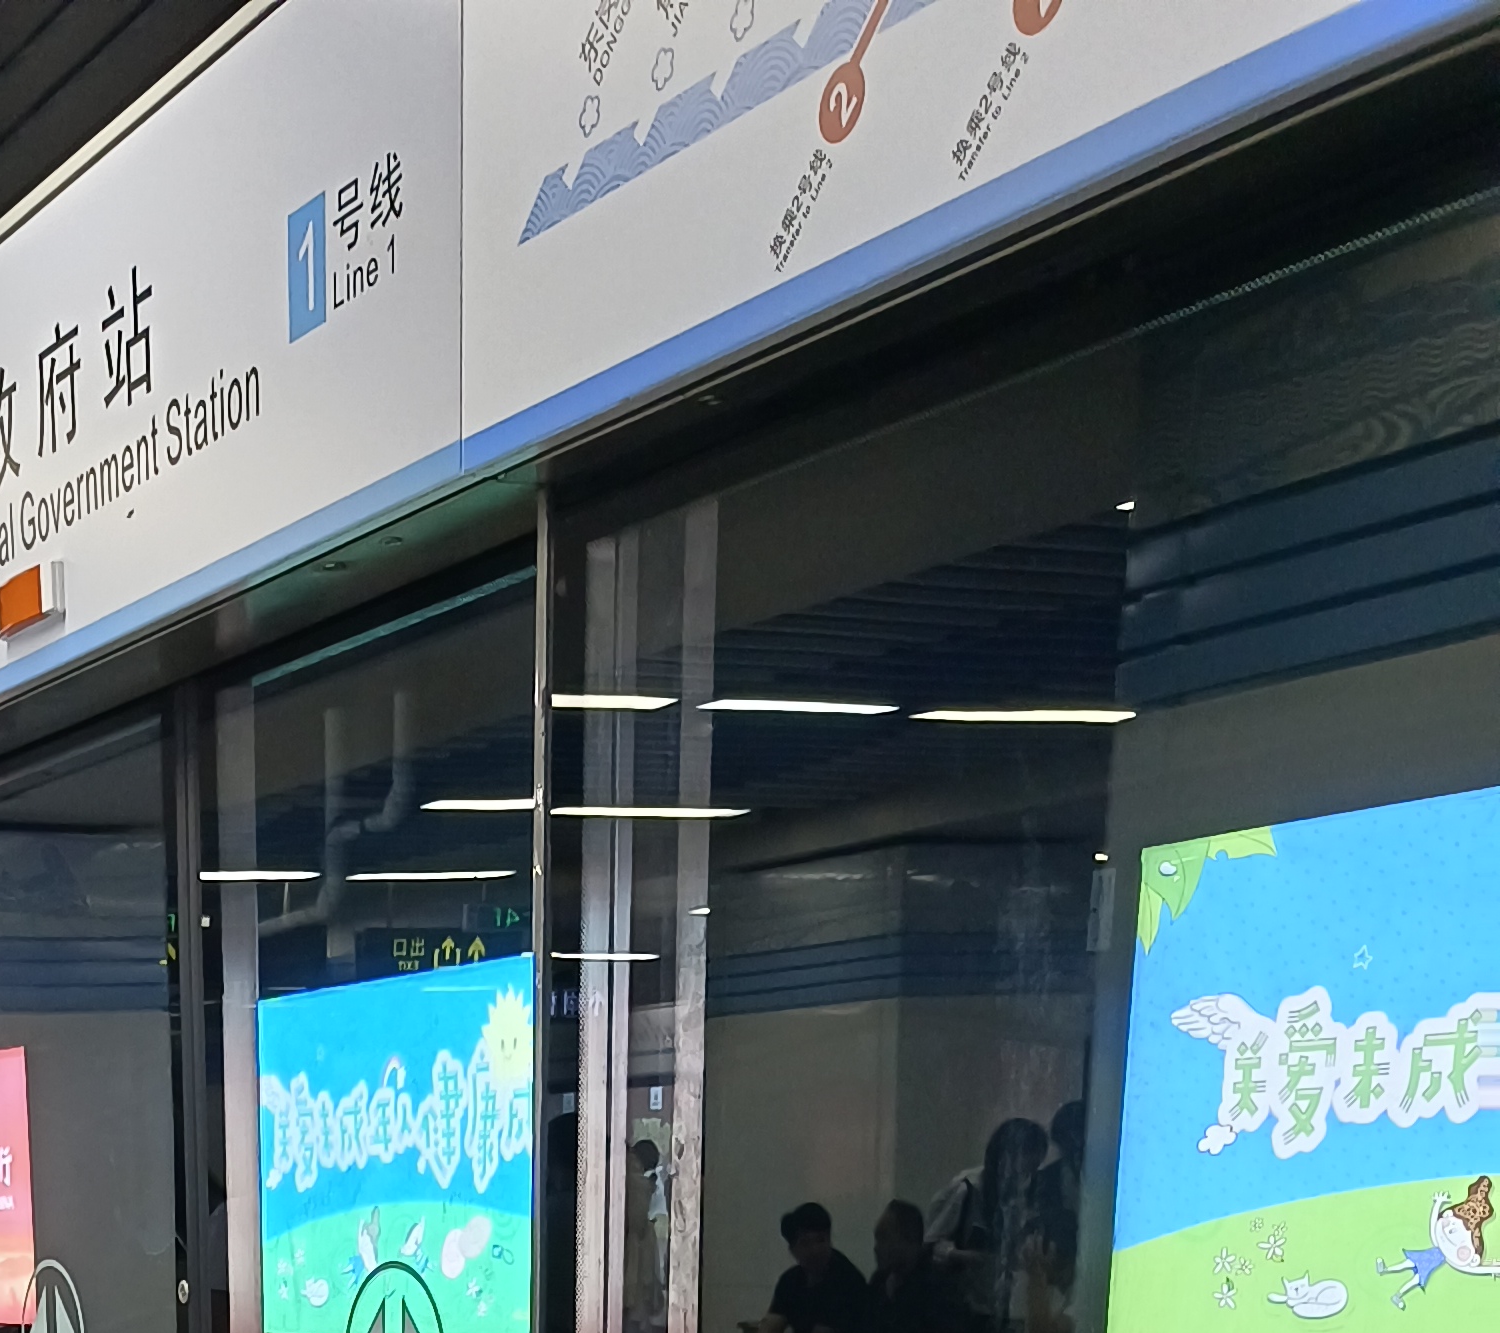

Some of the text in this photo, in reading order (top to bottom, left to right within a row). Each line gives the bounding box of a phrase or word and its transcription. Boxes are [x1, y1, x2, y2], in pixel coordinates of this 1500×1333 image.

[829, 82, 858, 128] 2
[958, 122, 993, 181] Transfer
[332, 152, 404, 251] 号线
[298, 220, 317, 311] 1
[332, 234, 397, 311] Line 1
[774, 223, 803, 273] Transfer
[20, 424, 159, 551] Government
[166, 365, 261, 468] Station
